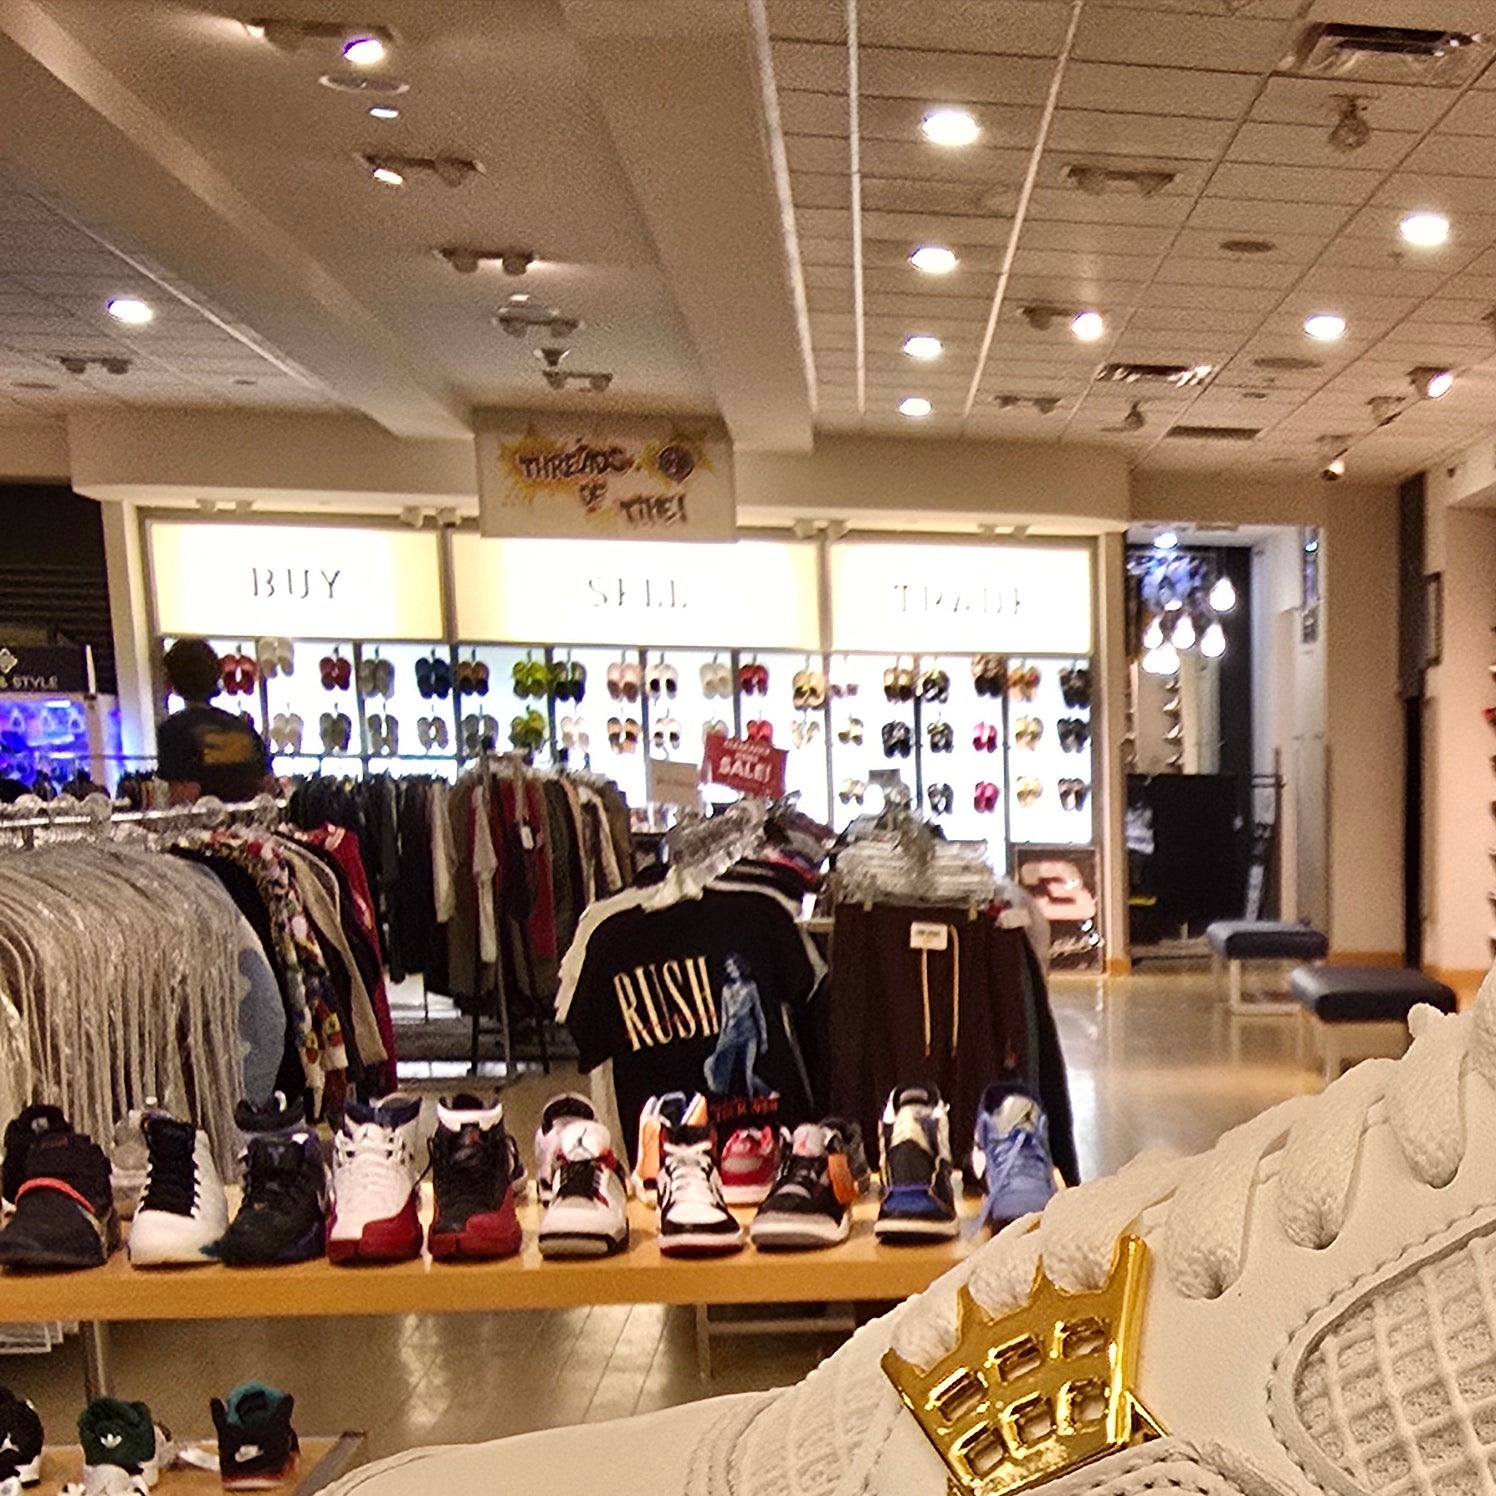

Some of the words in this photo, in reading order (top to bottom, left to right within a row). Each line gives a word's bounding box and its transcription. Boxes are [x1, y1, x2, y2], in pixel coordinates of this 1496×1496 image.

[252, 567, 341, 599] BUY
[718, 756, 773, 783] SALE!
[613, 956, 720, 1052] RUSH
